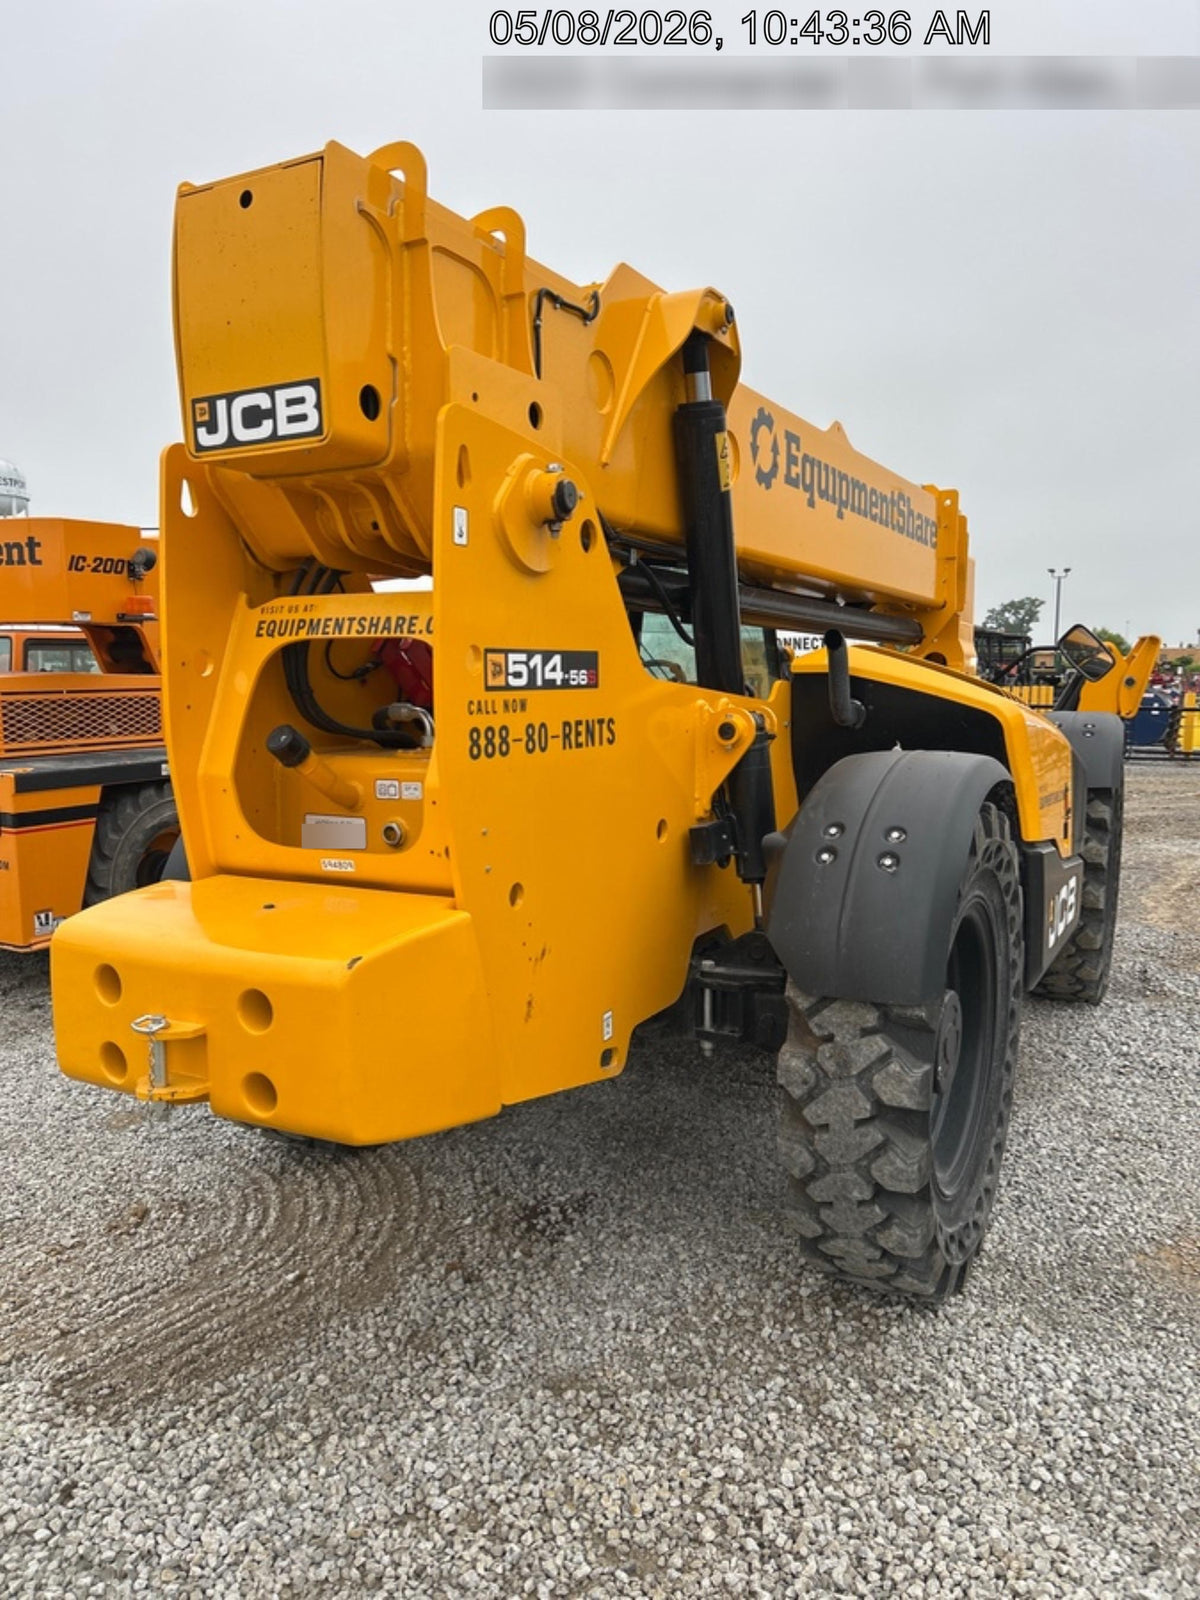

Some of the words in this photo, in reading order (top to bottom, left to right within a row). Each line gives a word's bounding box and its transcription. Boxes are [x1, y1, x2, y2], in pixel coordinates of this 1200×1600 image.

[196, 384, 320, 447] JCB
[784, 429, 938, 549] EquipmentShare
[0, 536, 43, 567] nt
[68, 554, 125, 575] IC-200
[467, 700, 498, 715] CALL
[503, 698, 528, 714] NOW
[468, 717, 616, 761] 888-80-RENTS
[1048, 875, 1077, 949] JCB
